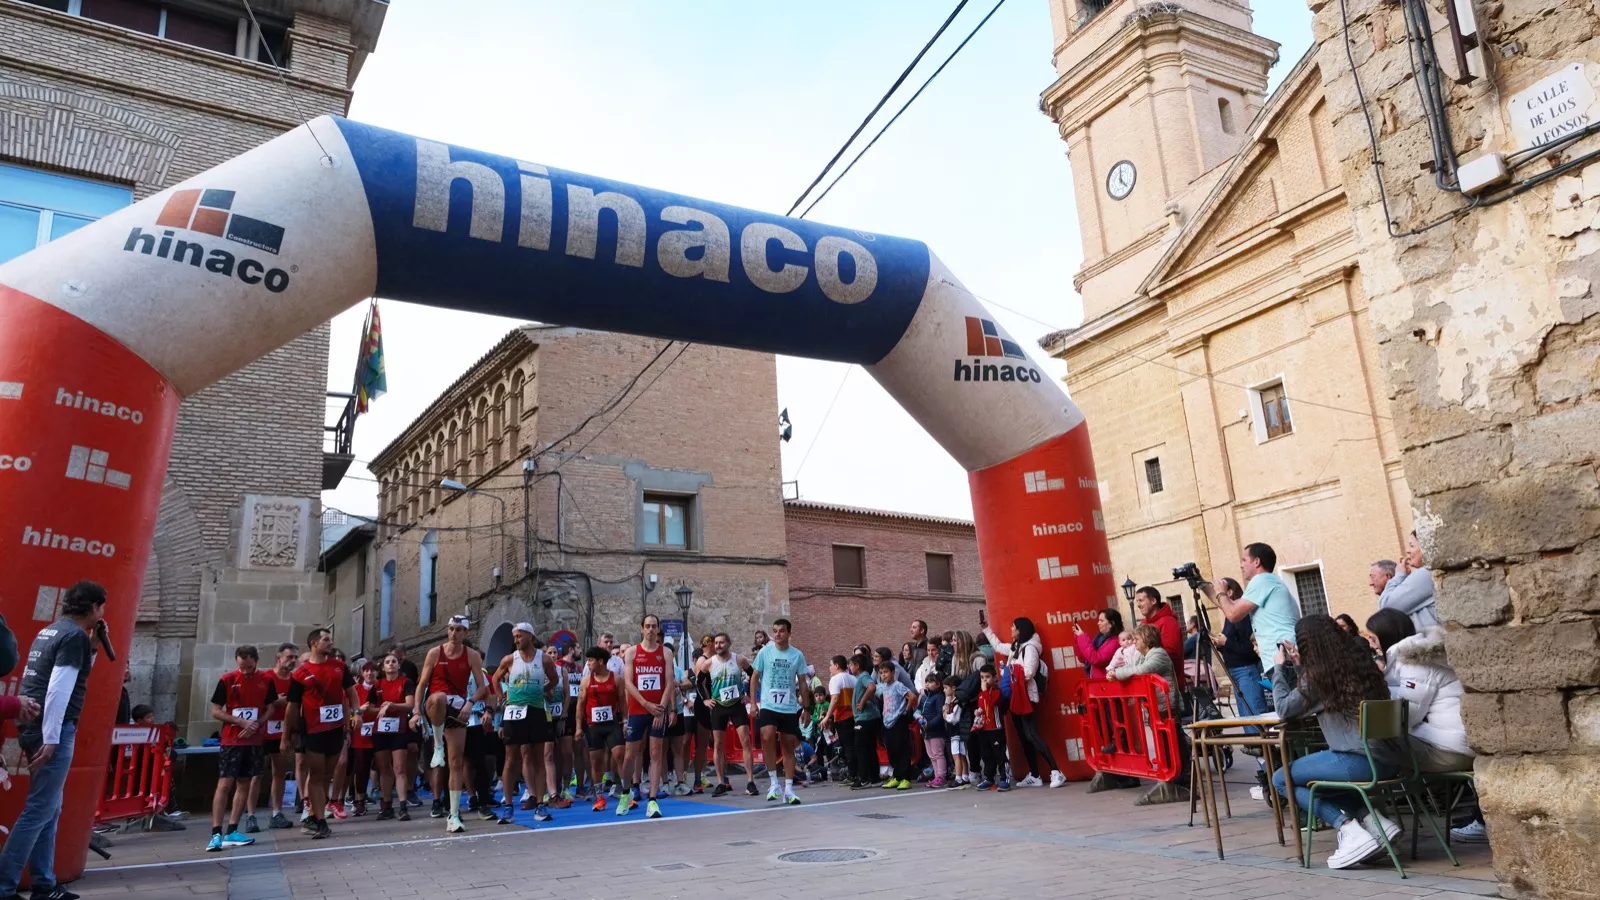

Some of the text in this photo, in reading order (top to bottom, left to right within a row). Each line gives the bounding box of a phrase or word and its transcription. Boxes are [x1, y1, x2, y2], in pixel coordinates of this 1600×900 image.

[1526, 80, 1569, 110] CALLE
[1530, 97, 1577, 129] DE LOS
[413, 138, 878, 304] hinaco
[227, 233, 278, 253] Constructora
[123, 227, 290, 293] hinaco
[954, 359, 1042, 383] hinaco
[55, 387, 143, 424] hinaco
[1032, 521, 1083, 536] hinaco
[22, 526, 115, 557] hinaco
[1046, 609, 1098, 625] hinaco
[642, 679, 656, 690] 57
[723, 690, 735, 700] 27
[773, 693, 786, 704] 17
[238, 711, 253, 720] 42
[325, 708, 340, 720] 28
[509, 710, 522, 720] 15
[595, 711, 609, 721] 39
[384, 722, 391, 732] 5
